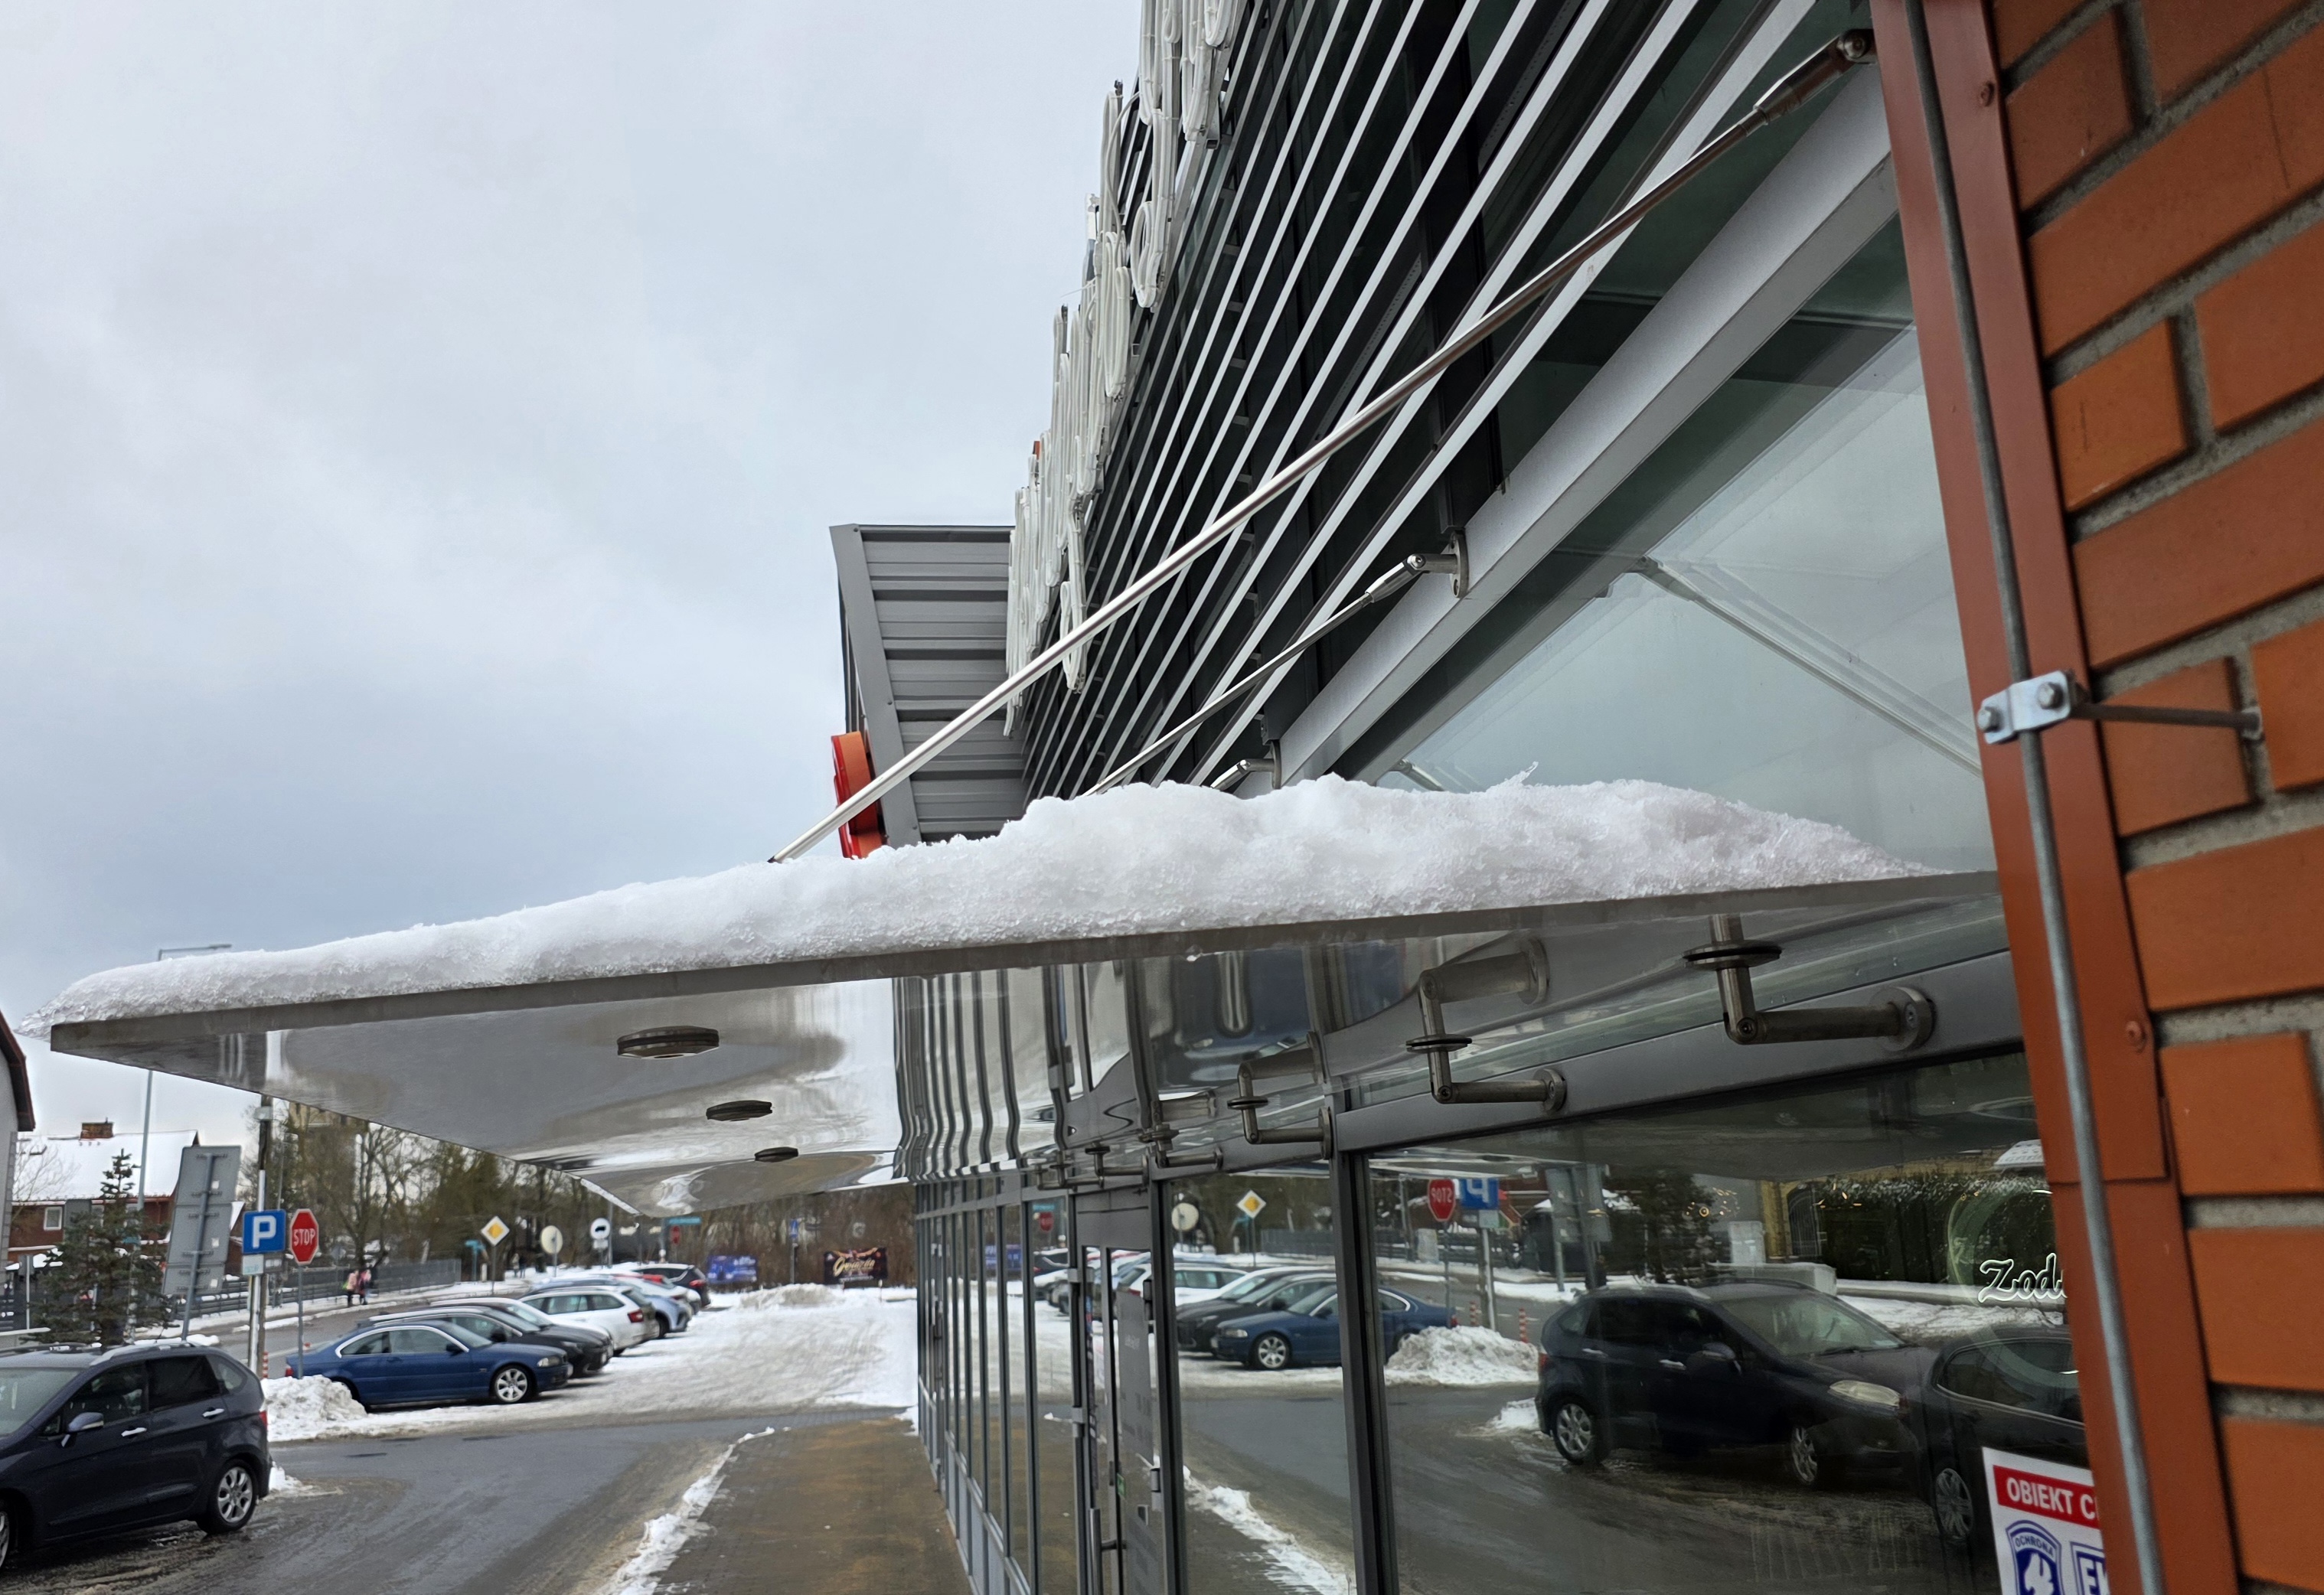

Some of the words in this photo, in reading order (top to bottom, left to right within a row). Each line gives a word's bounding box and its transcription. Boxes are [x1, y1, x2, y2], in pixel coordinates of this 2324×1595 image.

[253, 1215, 276, 1249] P
[293, 1228, 315, 1246] STOP
[1978, 1252, 2068, 1303] Zod
[2006, 1476, 2074, 1515] OBIEKT
[2080, 1493, 2100, 1522] C
[2015, 1535, 2054, 1558] OCHRONA
